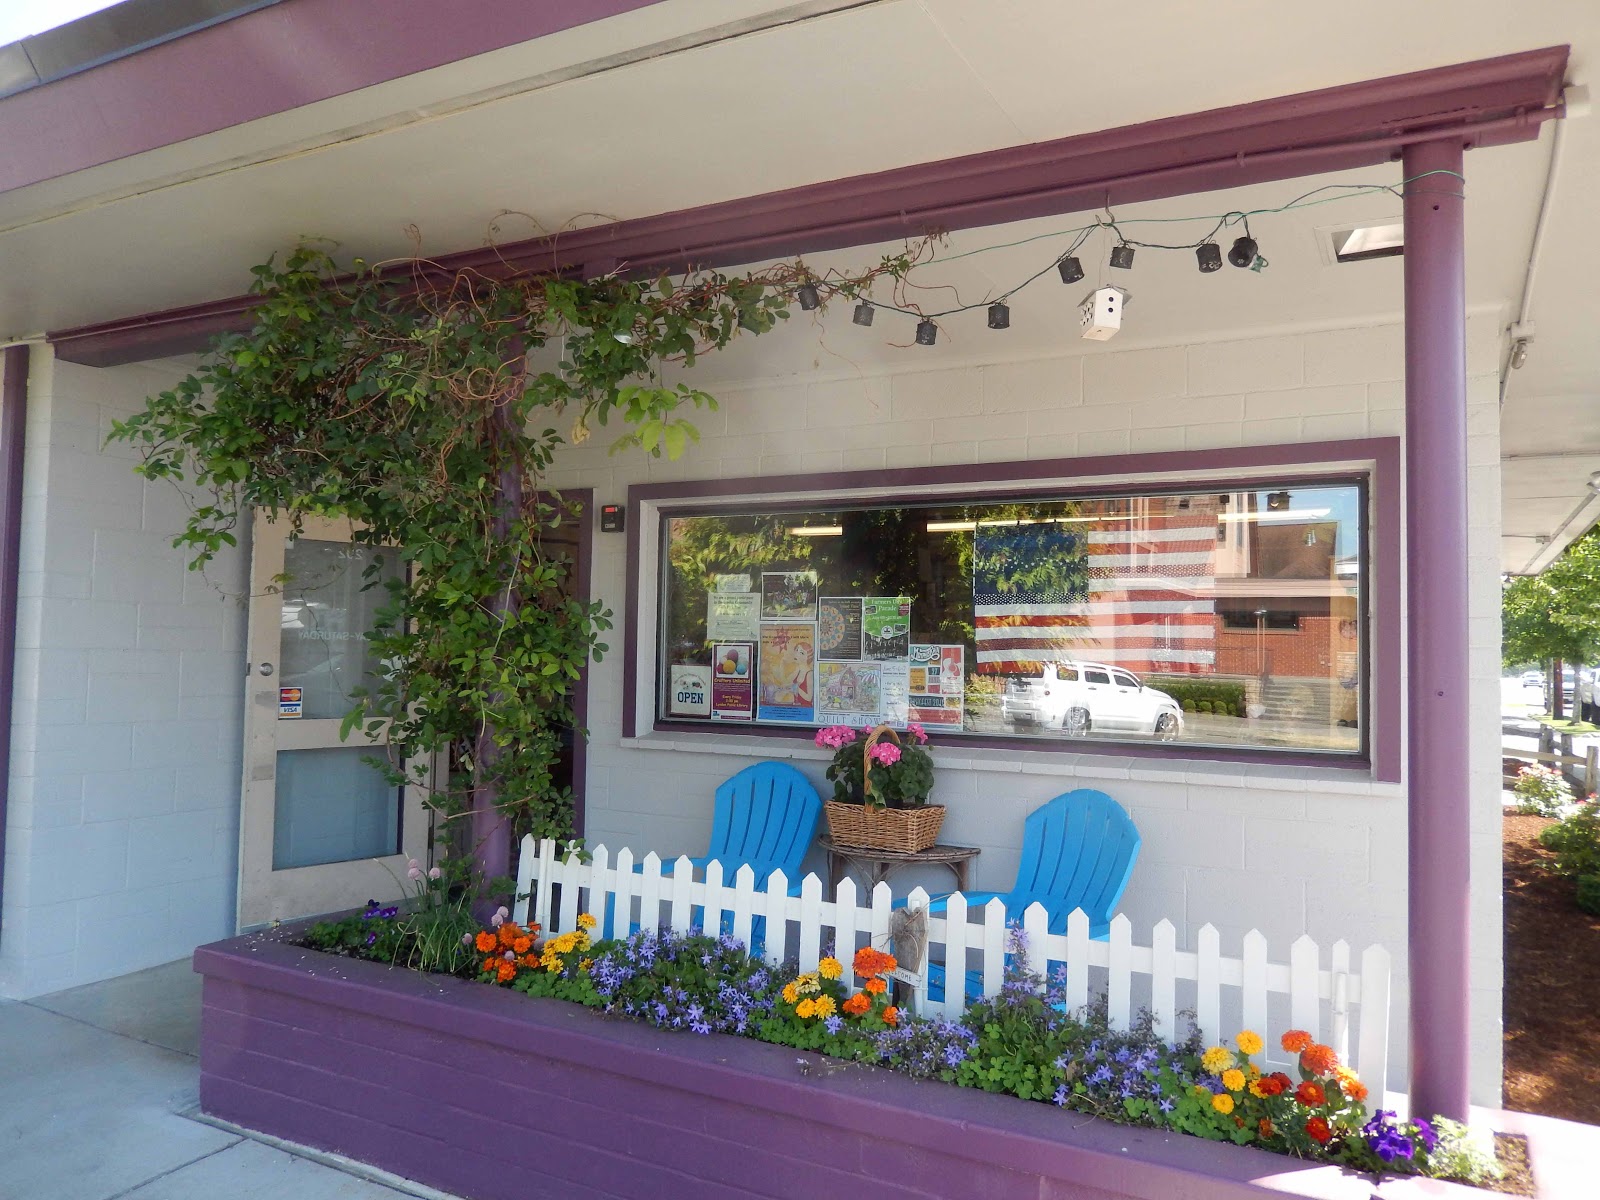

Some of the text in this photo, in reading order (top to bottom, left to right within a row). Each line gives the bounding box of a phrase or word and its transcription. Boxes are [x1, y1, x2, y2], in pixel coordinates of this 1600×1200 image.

[677, 691, 704, 704] OPEN
[818, 715, 846, 724] QUILT
[851, 716, 881, 725] SHOW
